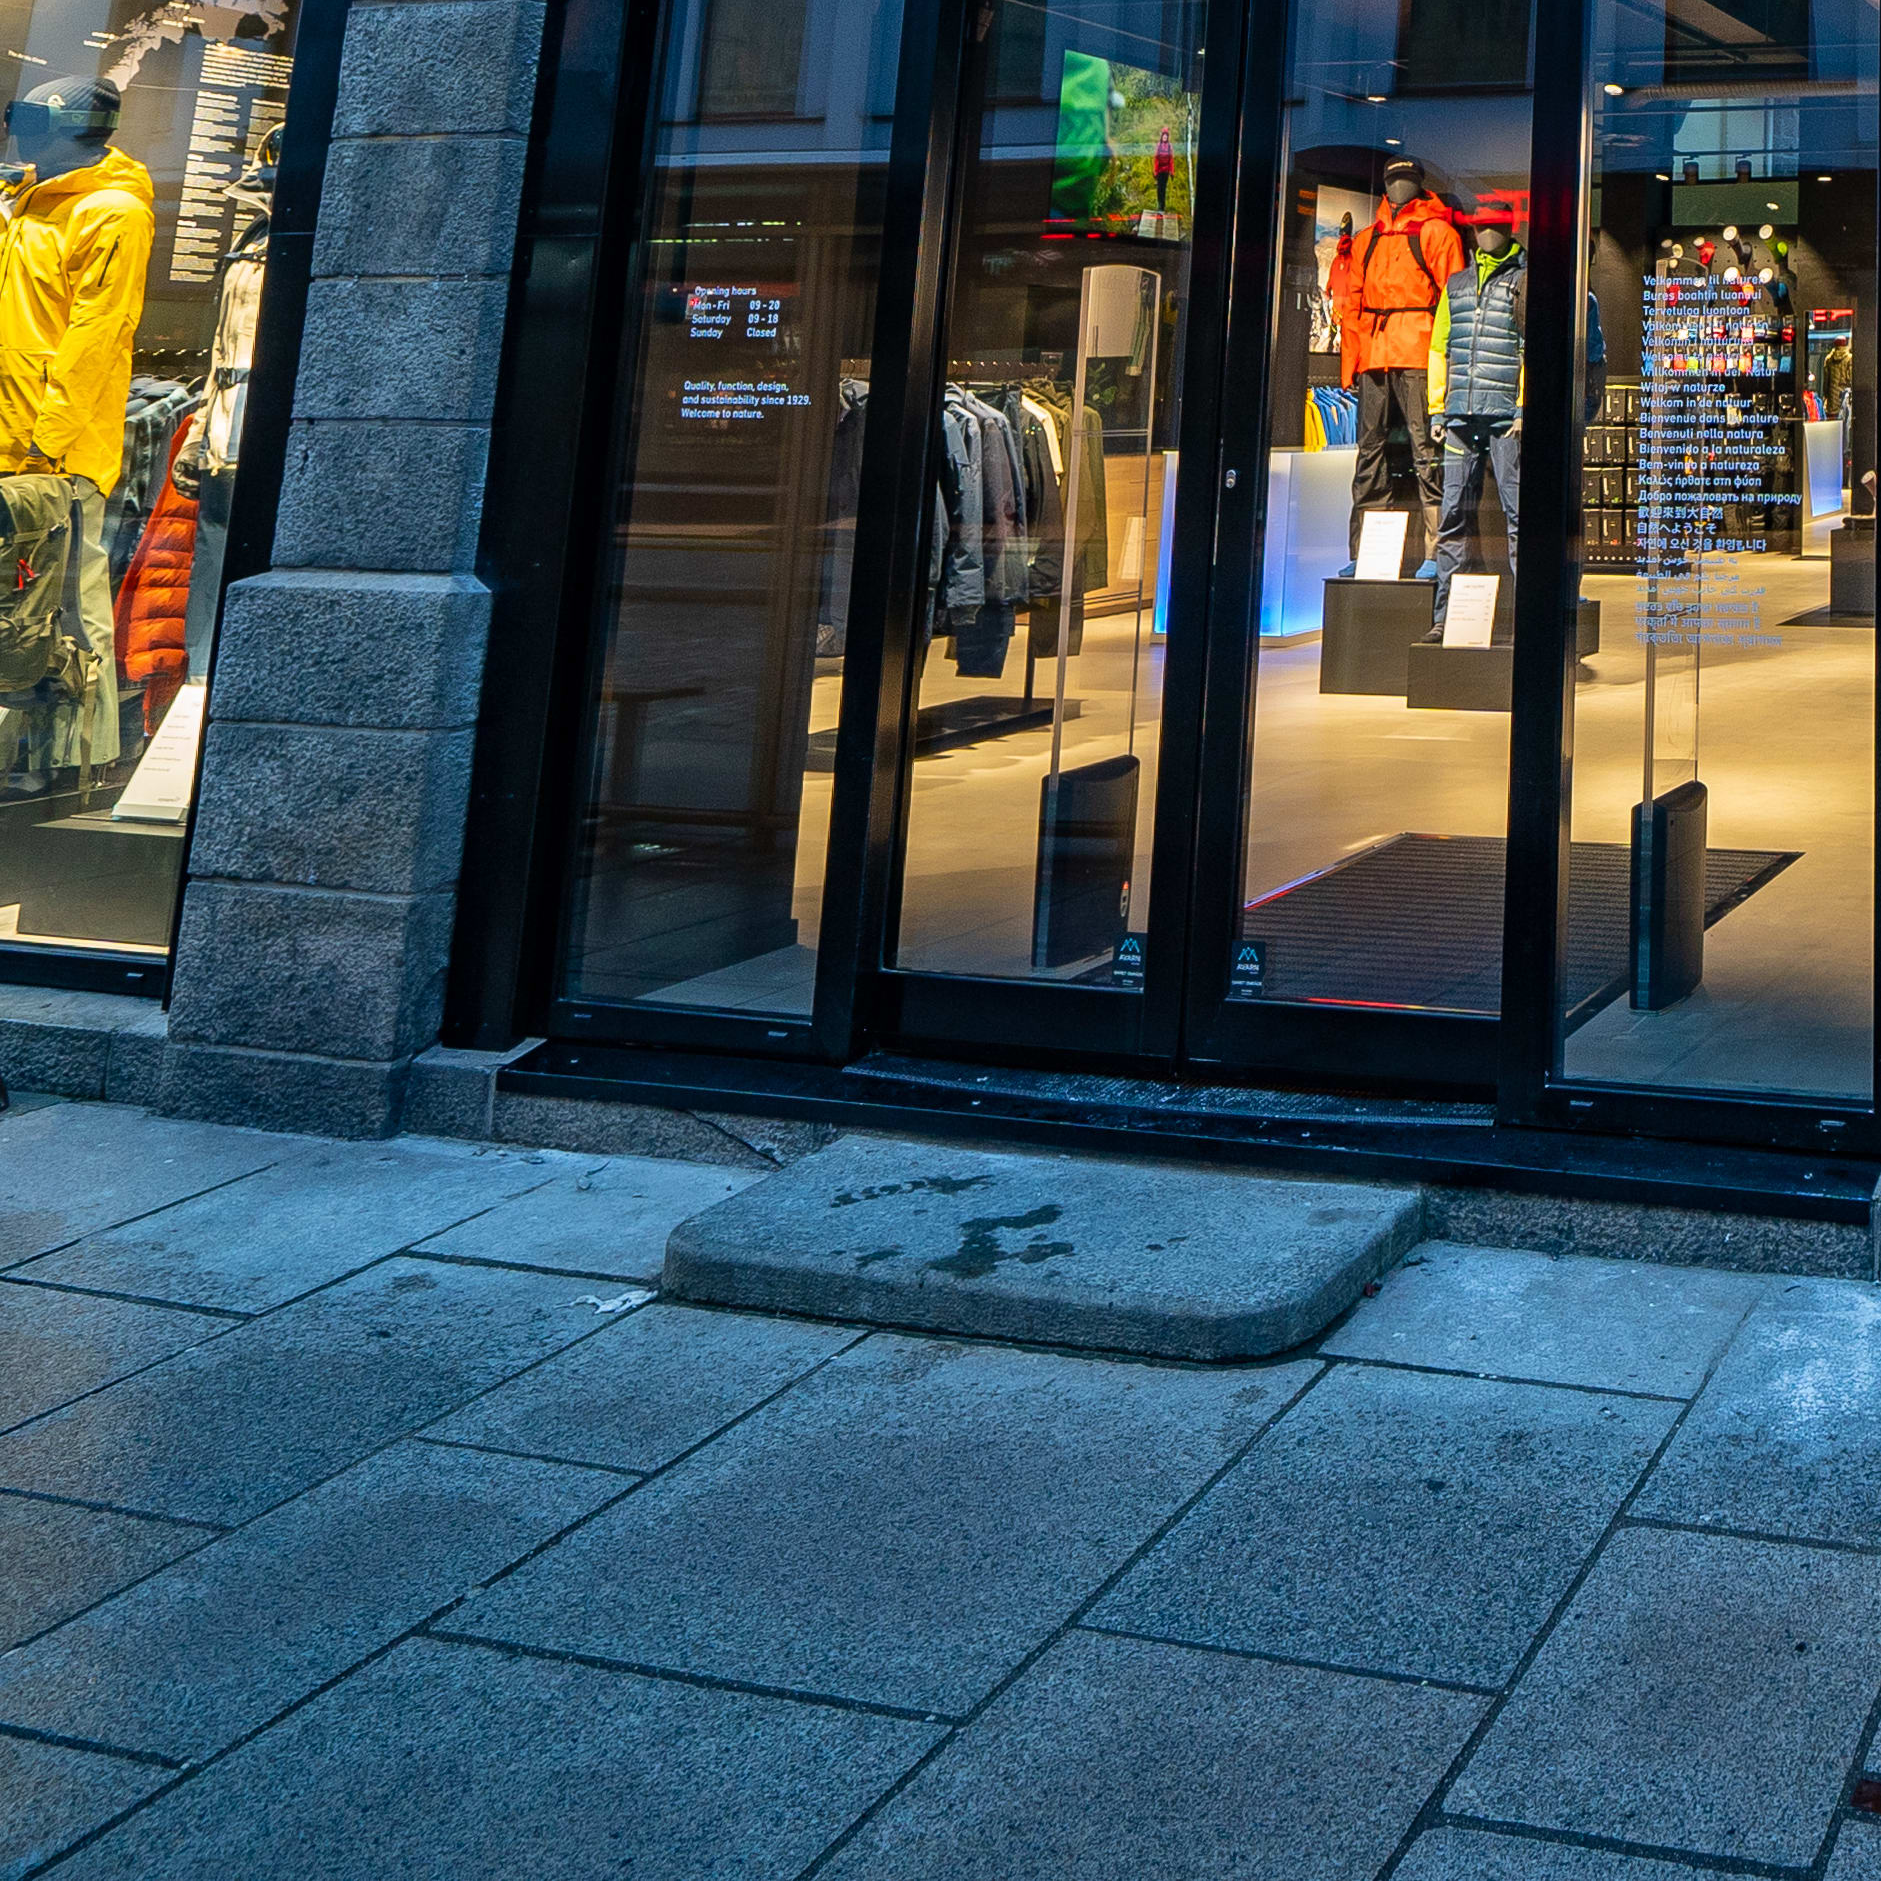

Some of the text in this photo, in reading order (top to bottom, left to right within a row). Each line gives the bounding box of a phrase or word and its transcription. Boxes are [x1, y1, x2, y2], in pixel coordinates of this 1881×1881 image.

[1708, 275, 1720, 285] til
[695, 286, 757, 298] Opening hours
[1643, 290, 1675, 300] Bures
[1678, 290, 1717, 300] boahtin
[749, 300, 761, 310] 09
[768, 300, 780, 310] 20
[1703, 305, 1750, 316] luontoon
[692, 314, 732, 326] Saturday
[748, 314, 760, 324] 09
[768, 314, 779, 324] 18
[690, 327, 777, 339] Sunday Closed
[684, 380, 789, 393] Quality, function, design,
[1641, 382, 1668, 394] Witaj
[1683, 382, 1726, 392] naturze
[682, 394, 812, 406] and sustainability since 1929.
[1640, 397, 1753, 407] Welkom in de natuur
[681, 408, 720, 418] Welcome
[722, 408, 731, 418] to
[1640, 412, 1697, 423] Bienvenue
[1700, 412, 1726, 423] dans
[1742, 413, 1779, 423] nature
[1640, 428, 1764, 439] Benvenuti nella natura
[1639, 443, 1699, 454] Bienvenido
[1712, 443, 1722, 454] la
[1725, 444, 1786, 454] naturaleza
[1639, 459, 1698, 470] Bem-vindo
[1710, 461, 1760, 470] natureza
[1638, 474, 1673, 488] Καλώς
[1734, 475, 1762, 489] φύση
[1638, 490, 1803, 505] Добро пожаловать на природу
